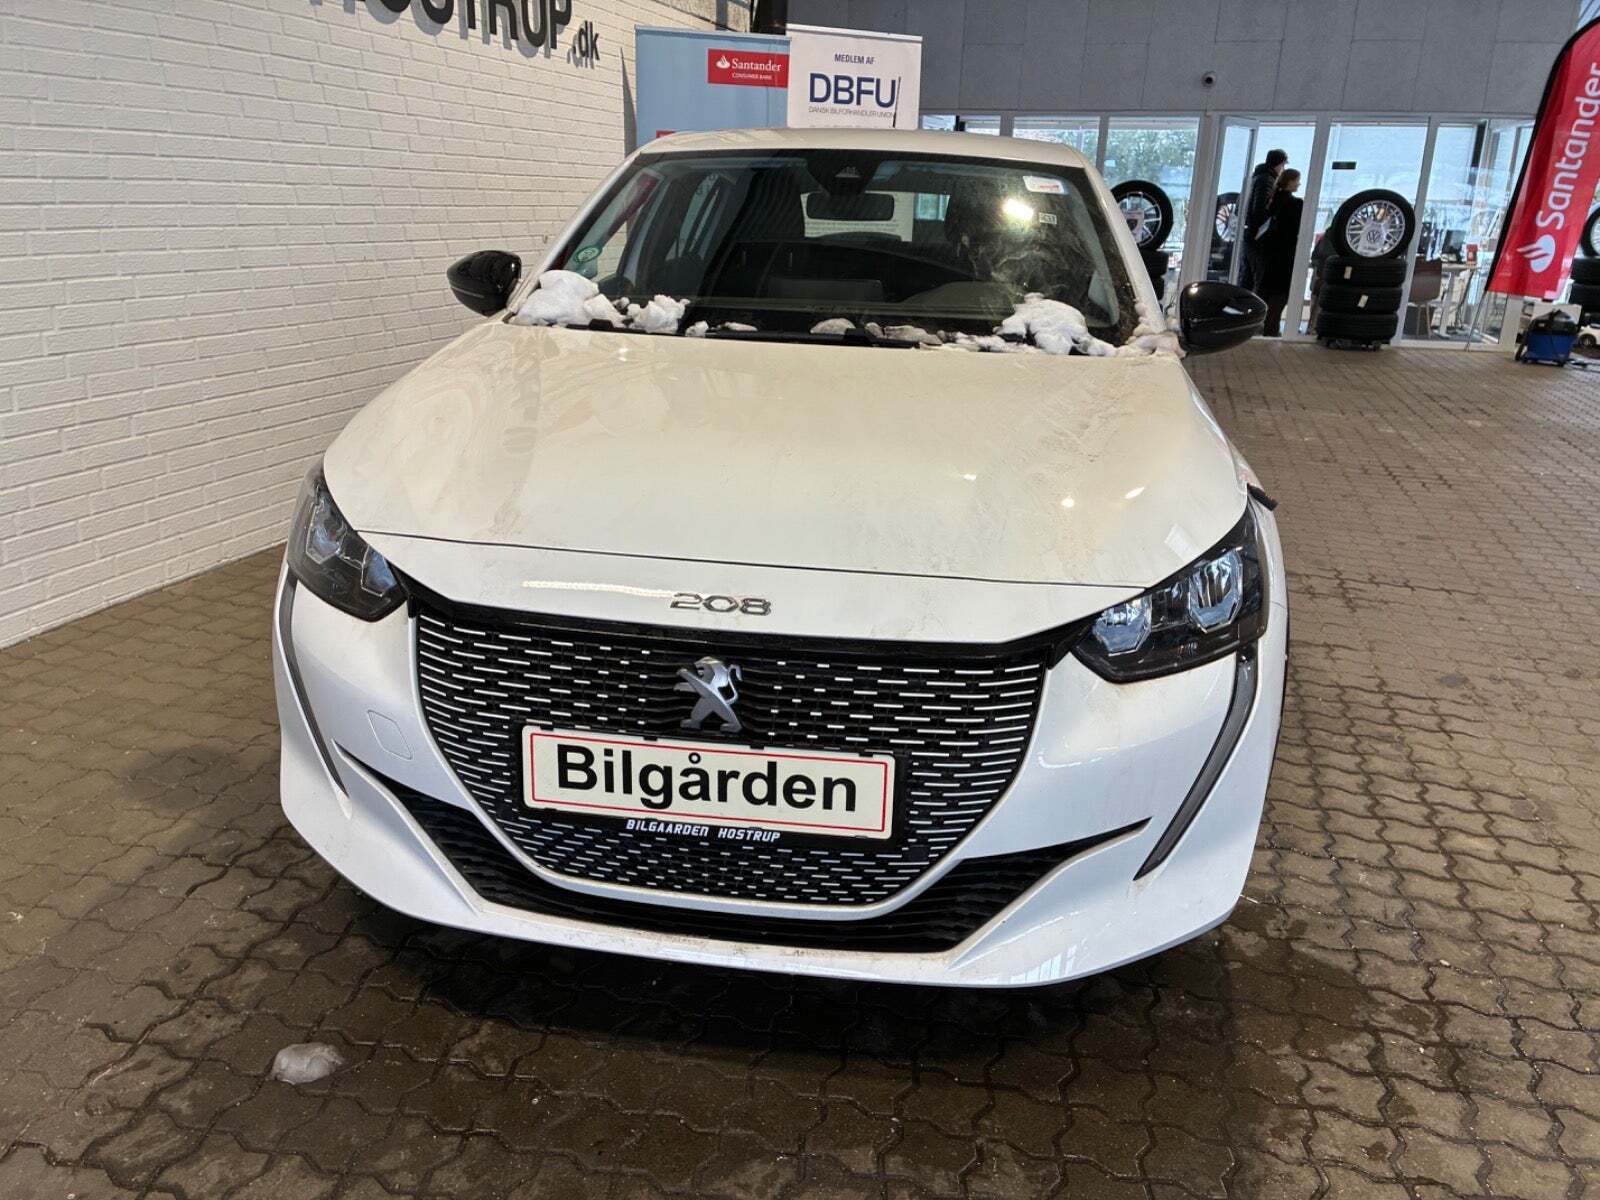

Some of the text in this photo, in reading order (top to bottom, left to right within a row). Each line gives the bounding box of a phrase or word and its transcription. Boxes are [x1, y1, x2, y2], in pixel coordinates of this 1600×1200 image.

[731, 57, 781, 72] Santander
[834, 53, 875, 65] MEDLEM AF
[809, 72, 896, 108] DBFU
[670, 591, 772, 616] 208
[556, 743, 857, 812] Bilgården
[626, 819, 780, 843] BILGAARDEN HOSTRUP
